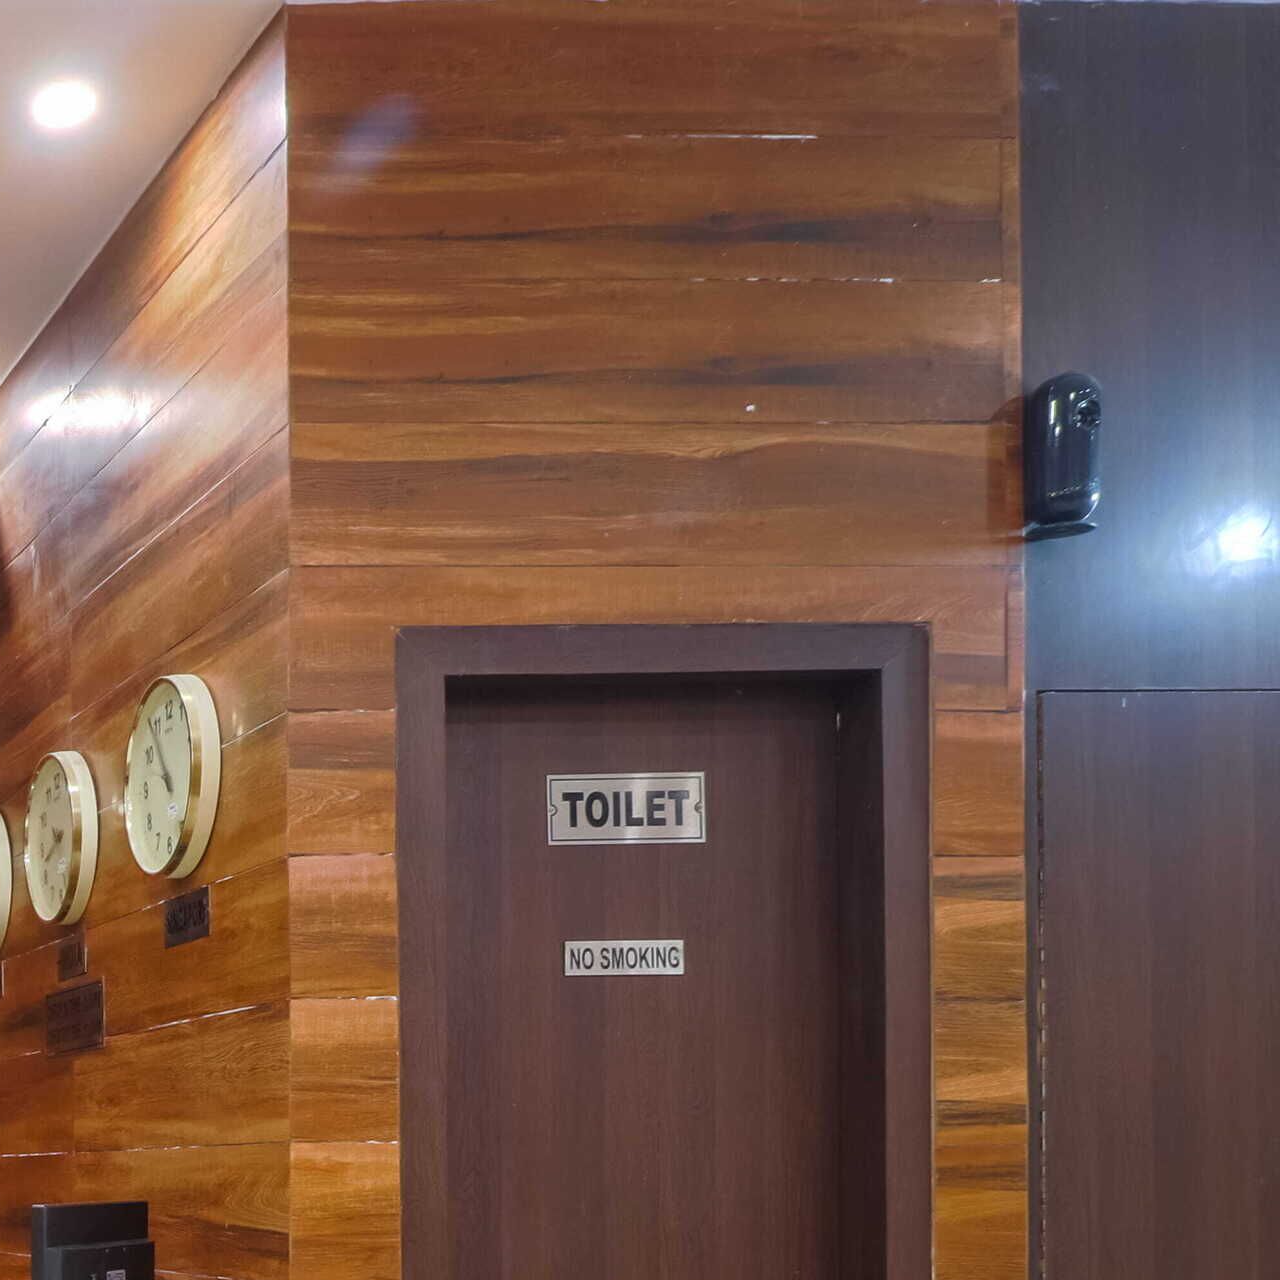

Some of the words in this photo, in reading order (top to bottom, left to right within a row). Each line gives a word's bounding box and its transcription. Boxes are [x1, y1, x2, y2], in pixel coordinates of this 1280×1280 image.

[165, 699, 173, 720] 12
[154, 717, 161, 737] 11
[145, 745, 153, 765] 10
[143, 781, 149, 800] 9
[562, 789, 690, 828] TOILET
[147, 813, 152, 831] 8
[156, 832, 160, 851] 7
[167, 836, 172, 854] 6
[569, 948, 594, 970] NO
[600, 946, 680, 970] SMOKING
